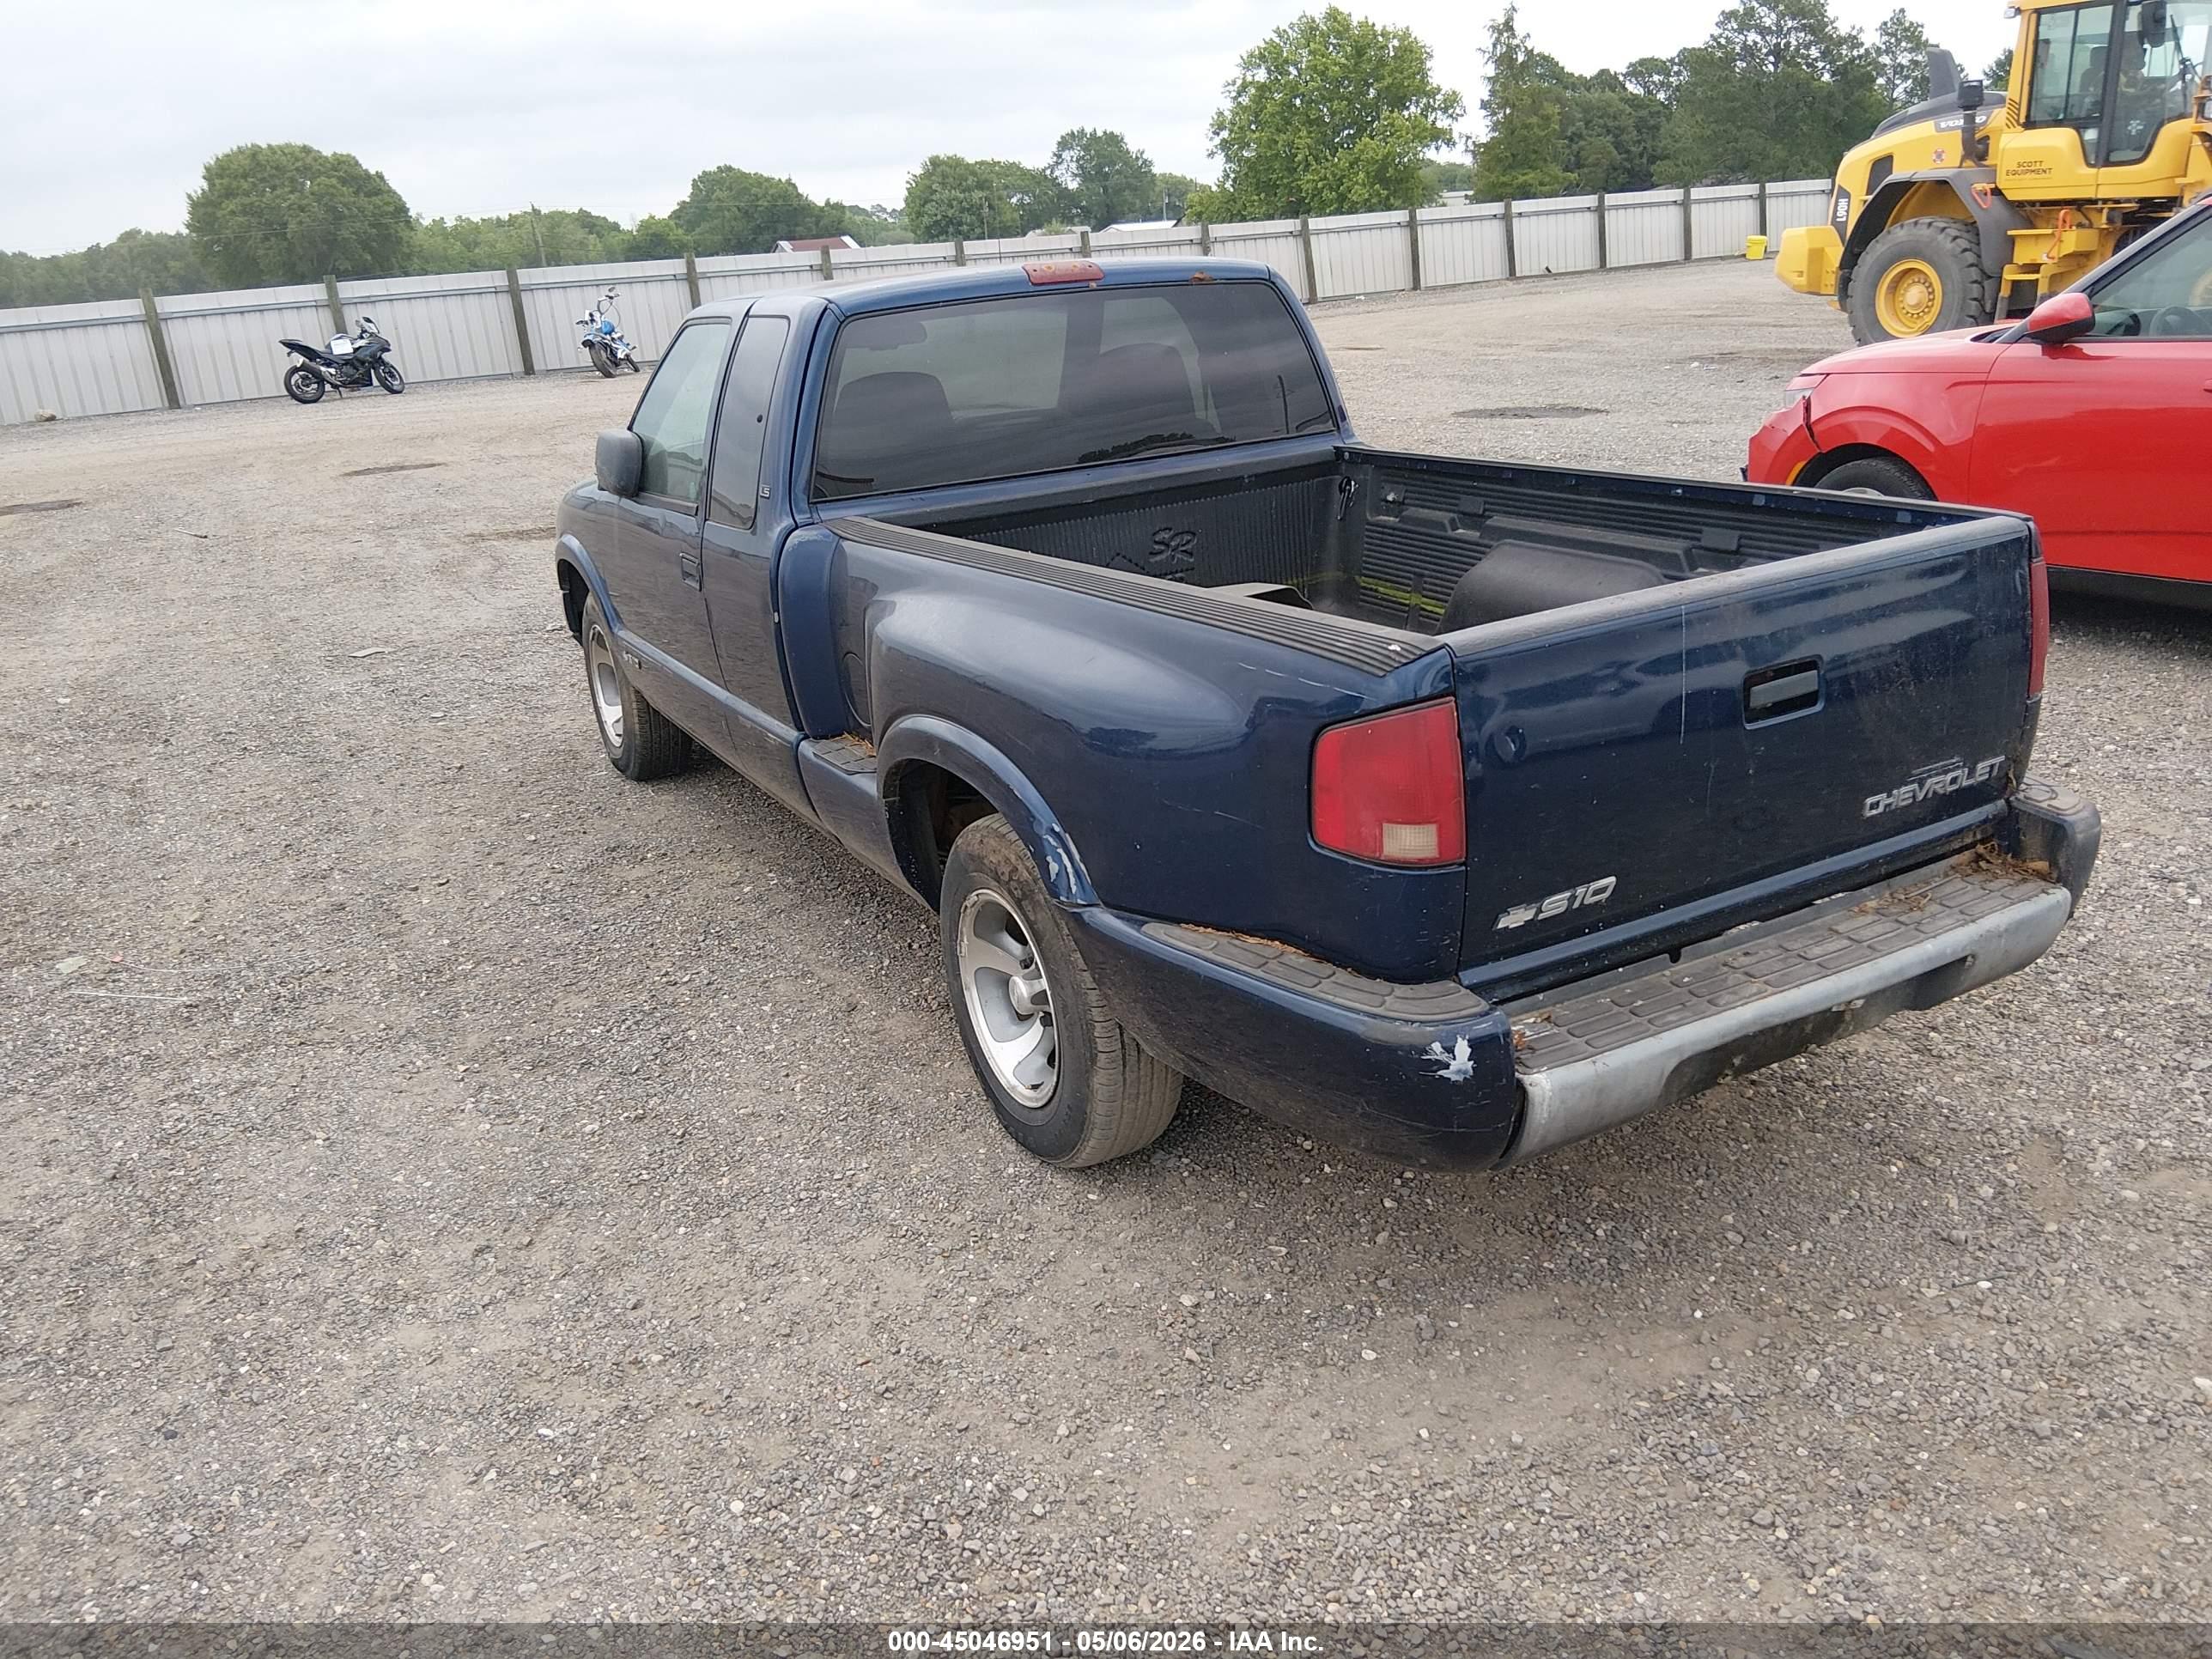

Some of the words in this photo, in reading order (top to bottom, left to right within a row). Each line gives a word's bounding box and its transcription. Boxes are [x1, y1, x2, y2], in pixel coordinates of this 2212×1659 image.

[1939, 116, 1986, 128] VOLO
[2016, 160, 2045, 168] SCOTT
[2005, 167, 2053, 177] EQUIPMENT
[1836, 198, 1849, 222] L90H
[759, 486, 770, 498] LS
[1863, 755, 2006, 817] CHEVROLET
[1537, 875, 1617, 921] S10
